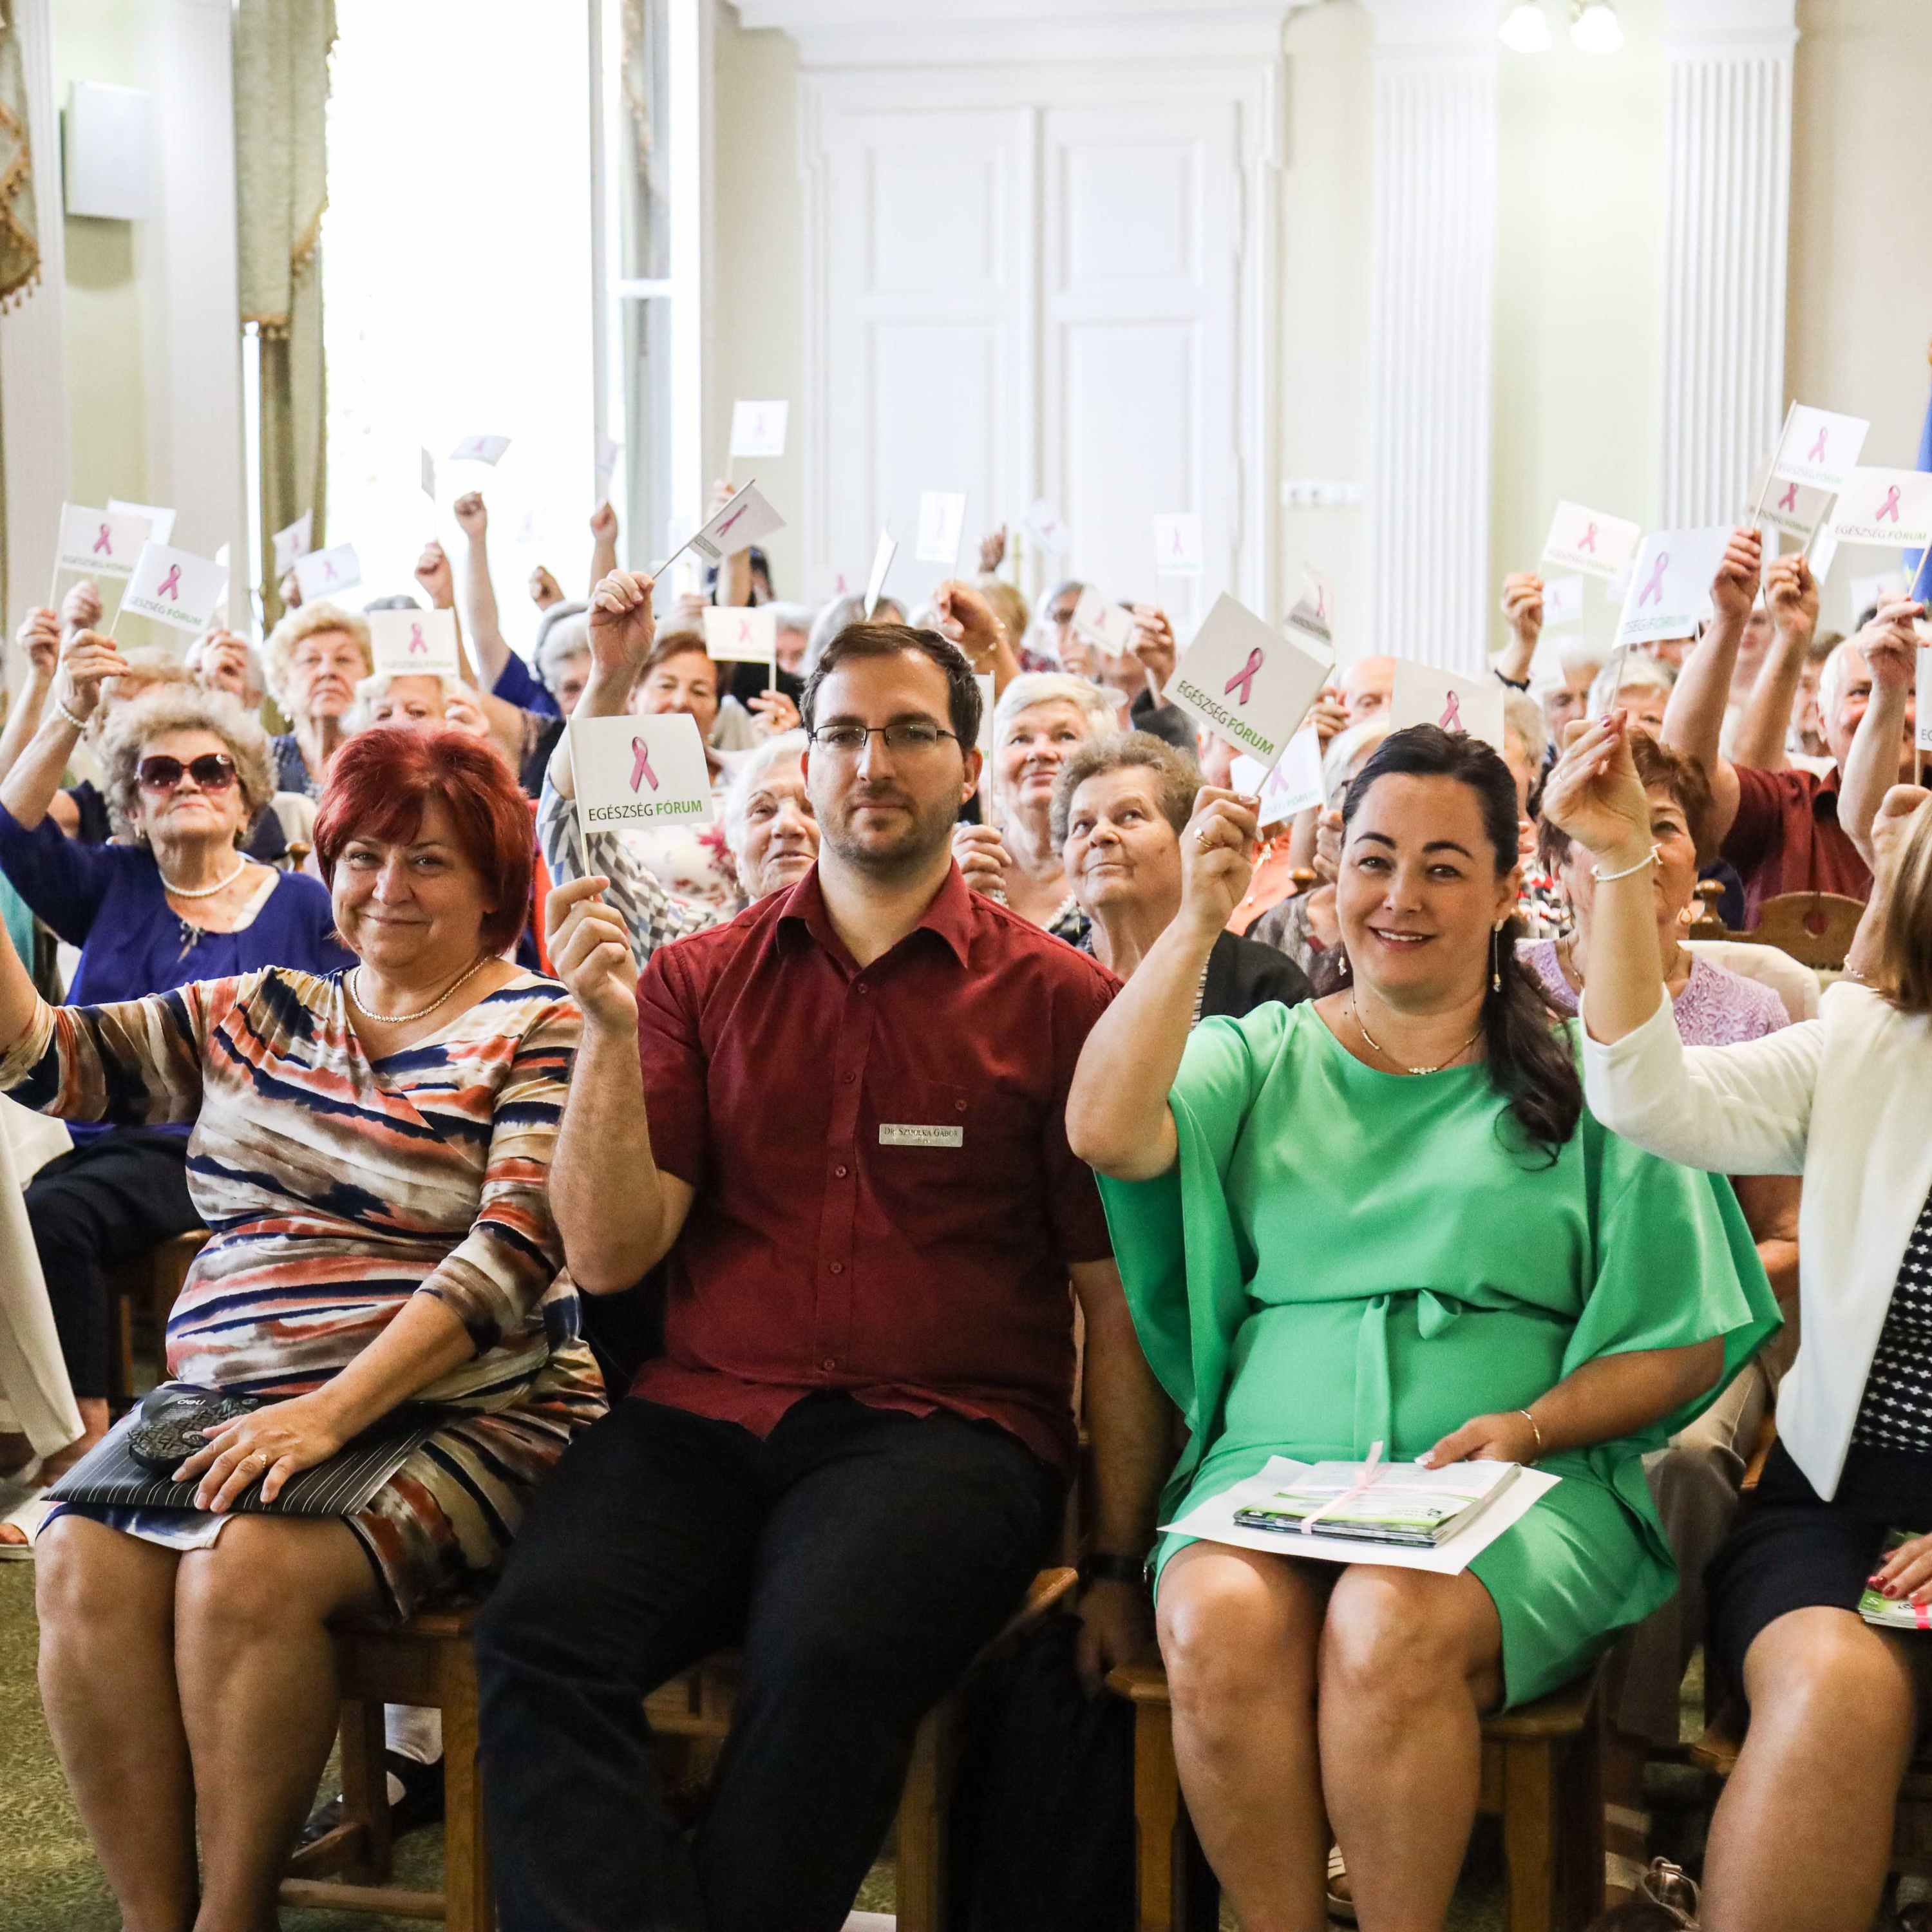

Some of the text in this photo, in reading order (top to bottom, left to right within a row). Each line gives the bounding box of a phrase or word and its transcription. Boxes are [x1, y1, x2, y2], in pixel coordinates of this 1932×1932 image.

[1835, 524, 1927, 541] EGÉSZSÉG FÓRUM
[1177, 680, 1274, 755] EGÉSZSÉG FÓRUM
[589, 799, 703, 821] EGÉSZSÉG FÓRUM
